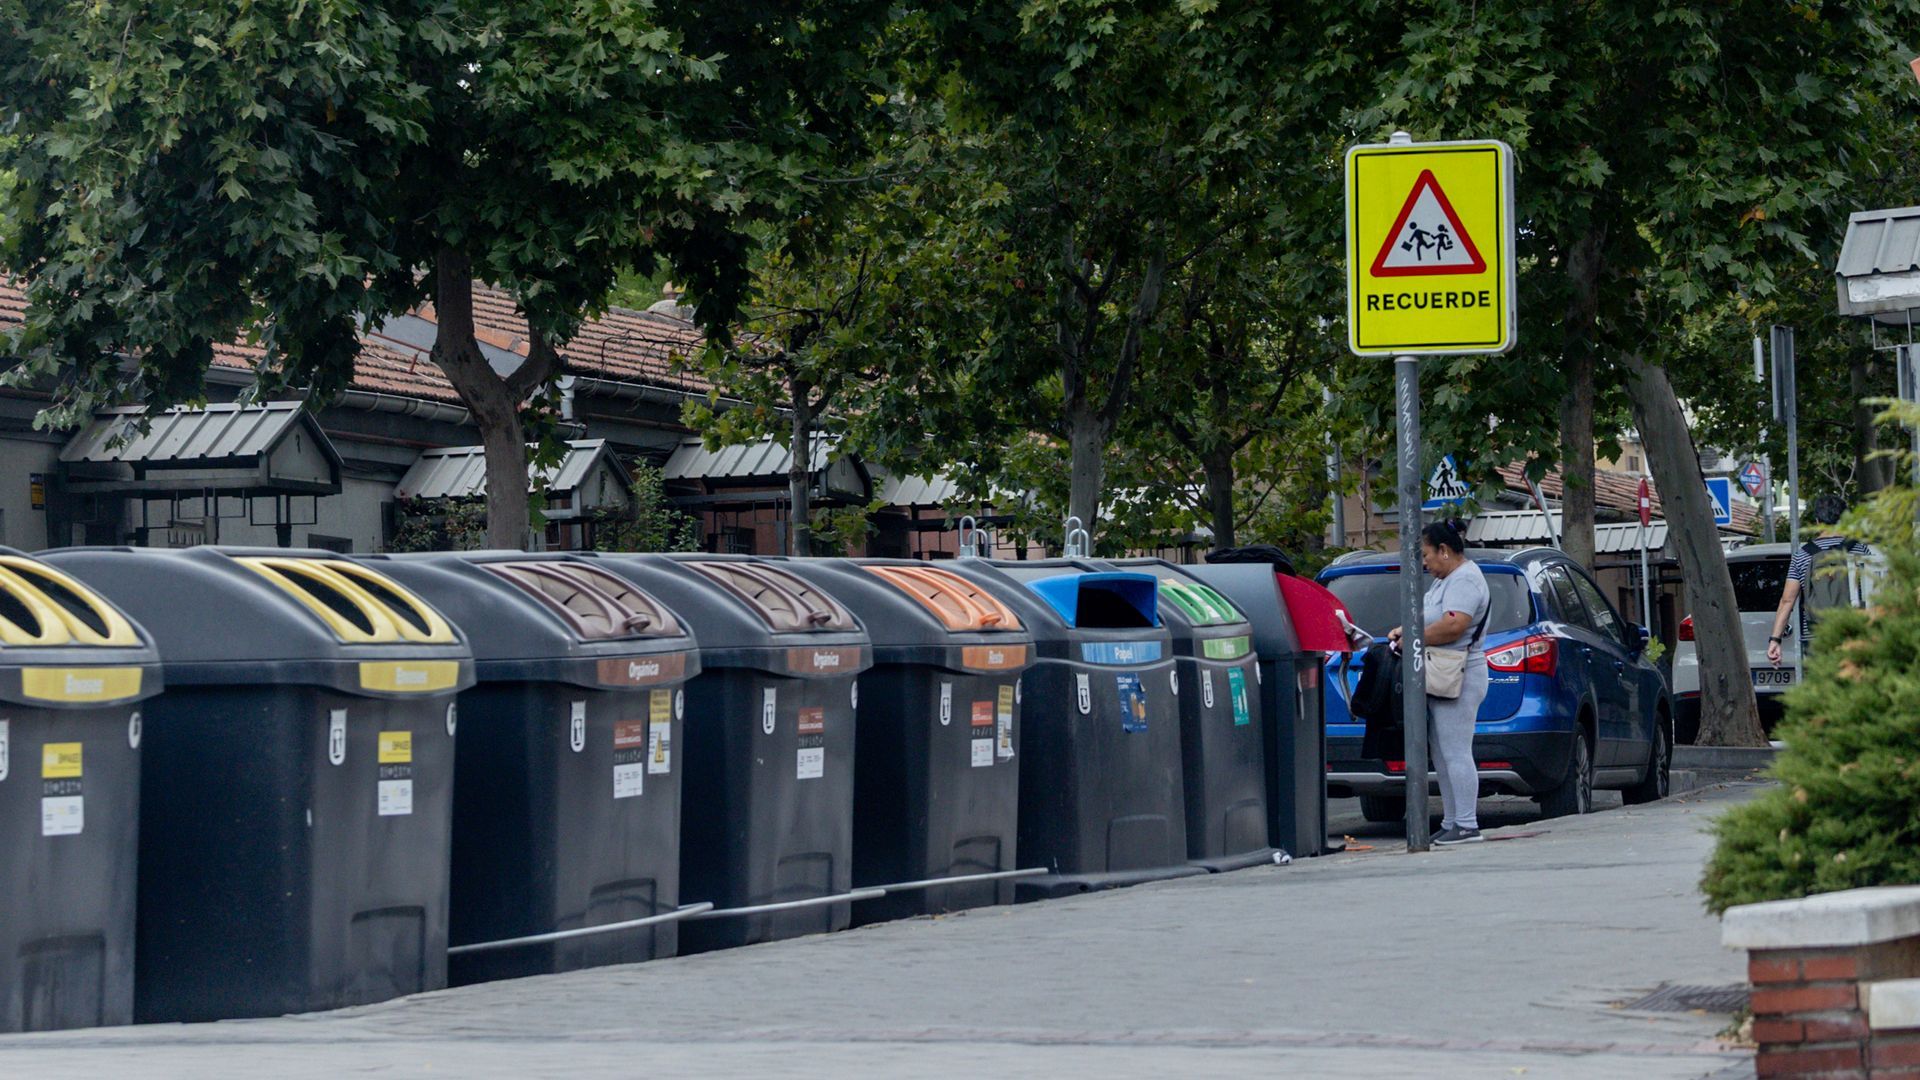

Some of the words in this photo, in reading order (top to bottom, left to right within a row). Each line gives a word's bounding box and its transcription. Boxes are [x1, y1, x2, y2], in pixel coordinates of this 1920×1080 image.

[1366, 290, 1491, 311] RECUERDE
[812, 651, 840, 670] Orgánica
[1113, 646, 1133, 663] Papel
[628, 660, 660, 681] Orgánica
[1757, 671, 1791, 684] 9709
